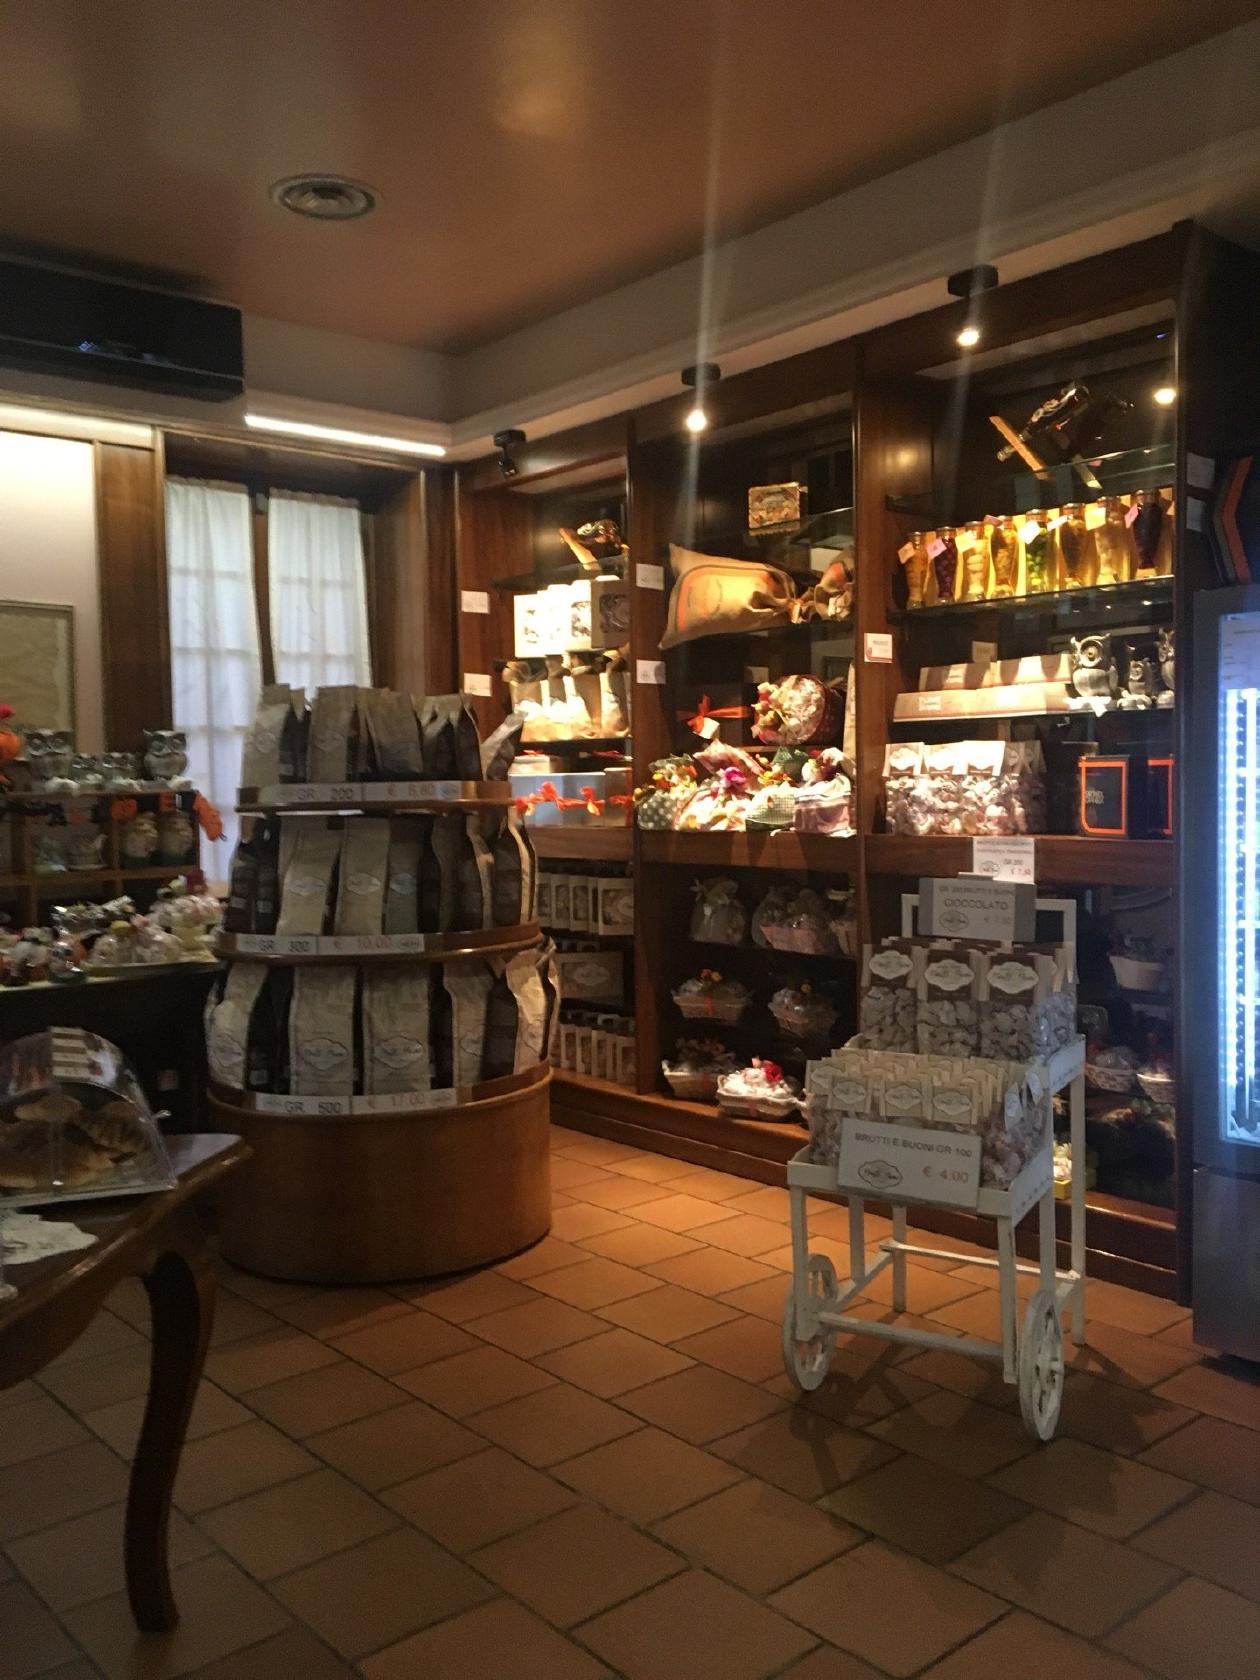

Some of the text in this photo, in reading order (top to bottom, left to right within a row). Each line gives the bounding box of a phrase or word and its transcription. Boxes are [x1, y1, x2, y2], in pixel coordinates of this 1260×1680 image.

[944, 898, 1009, 911] CIOCCOLATO
[318, 1101, 342, 1114] 500
[854, 1132, 973, 1158] BRUTTI E BUONI GR 100
[921, 1165, 933, 1178] €
